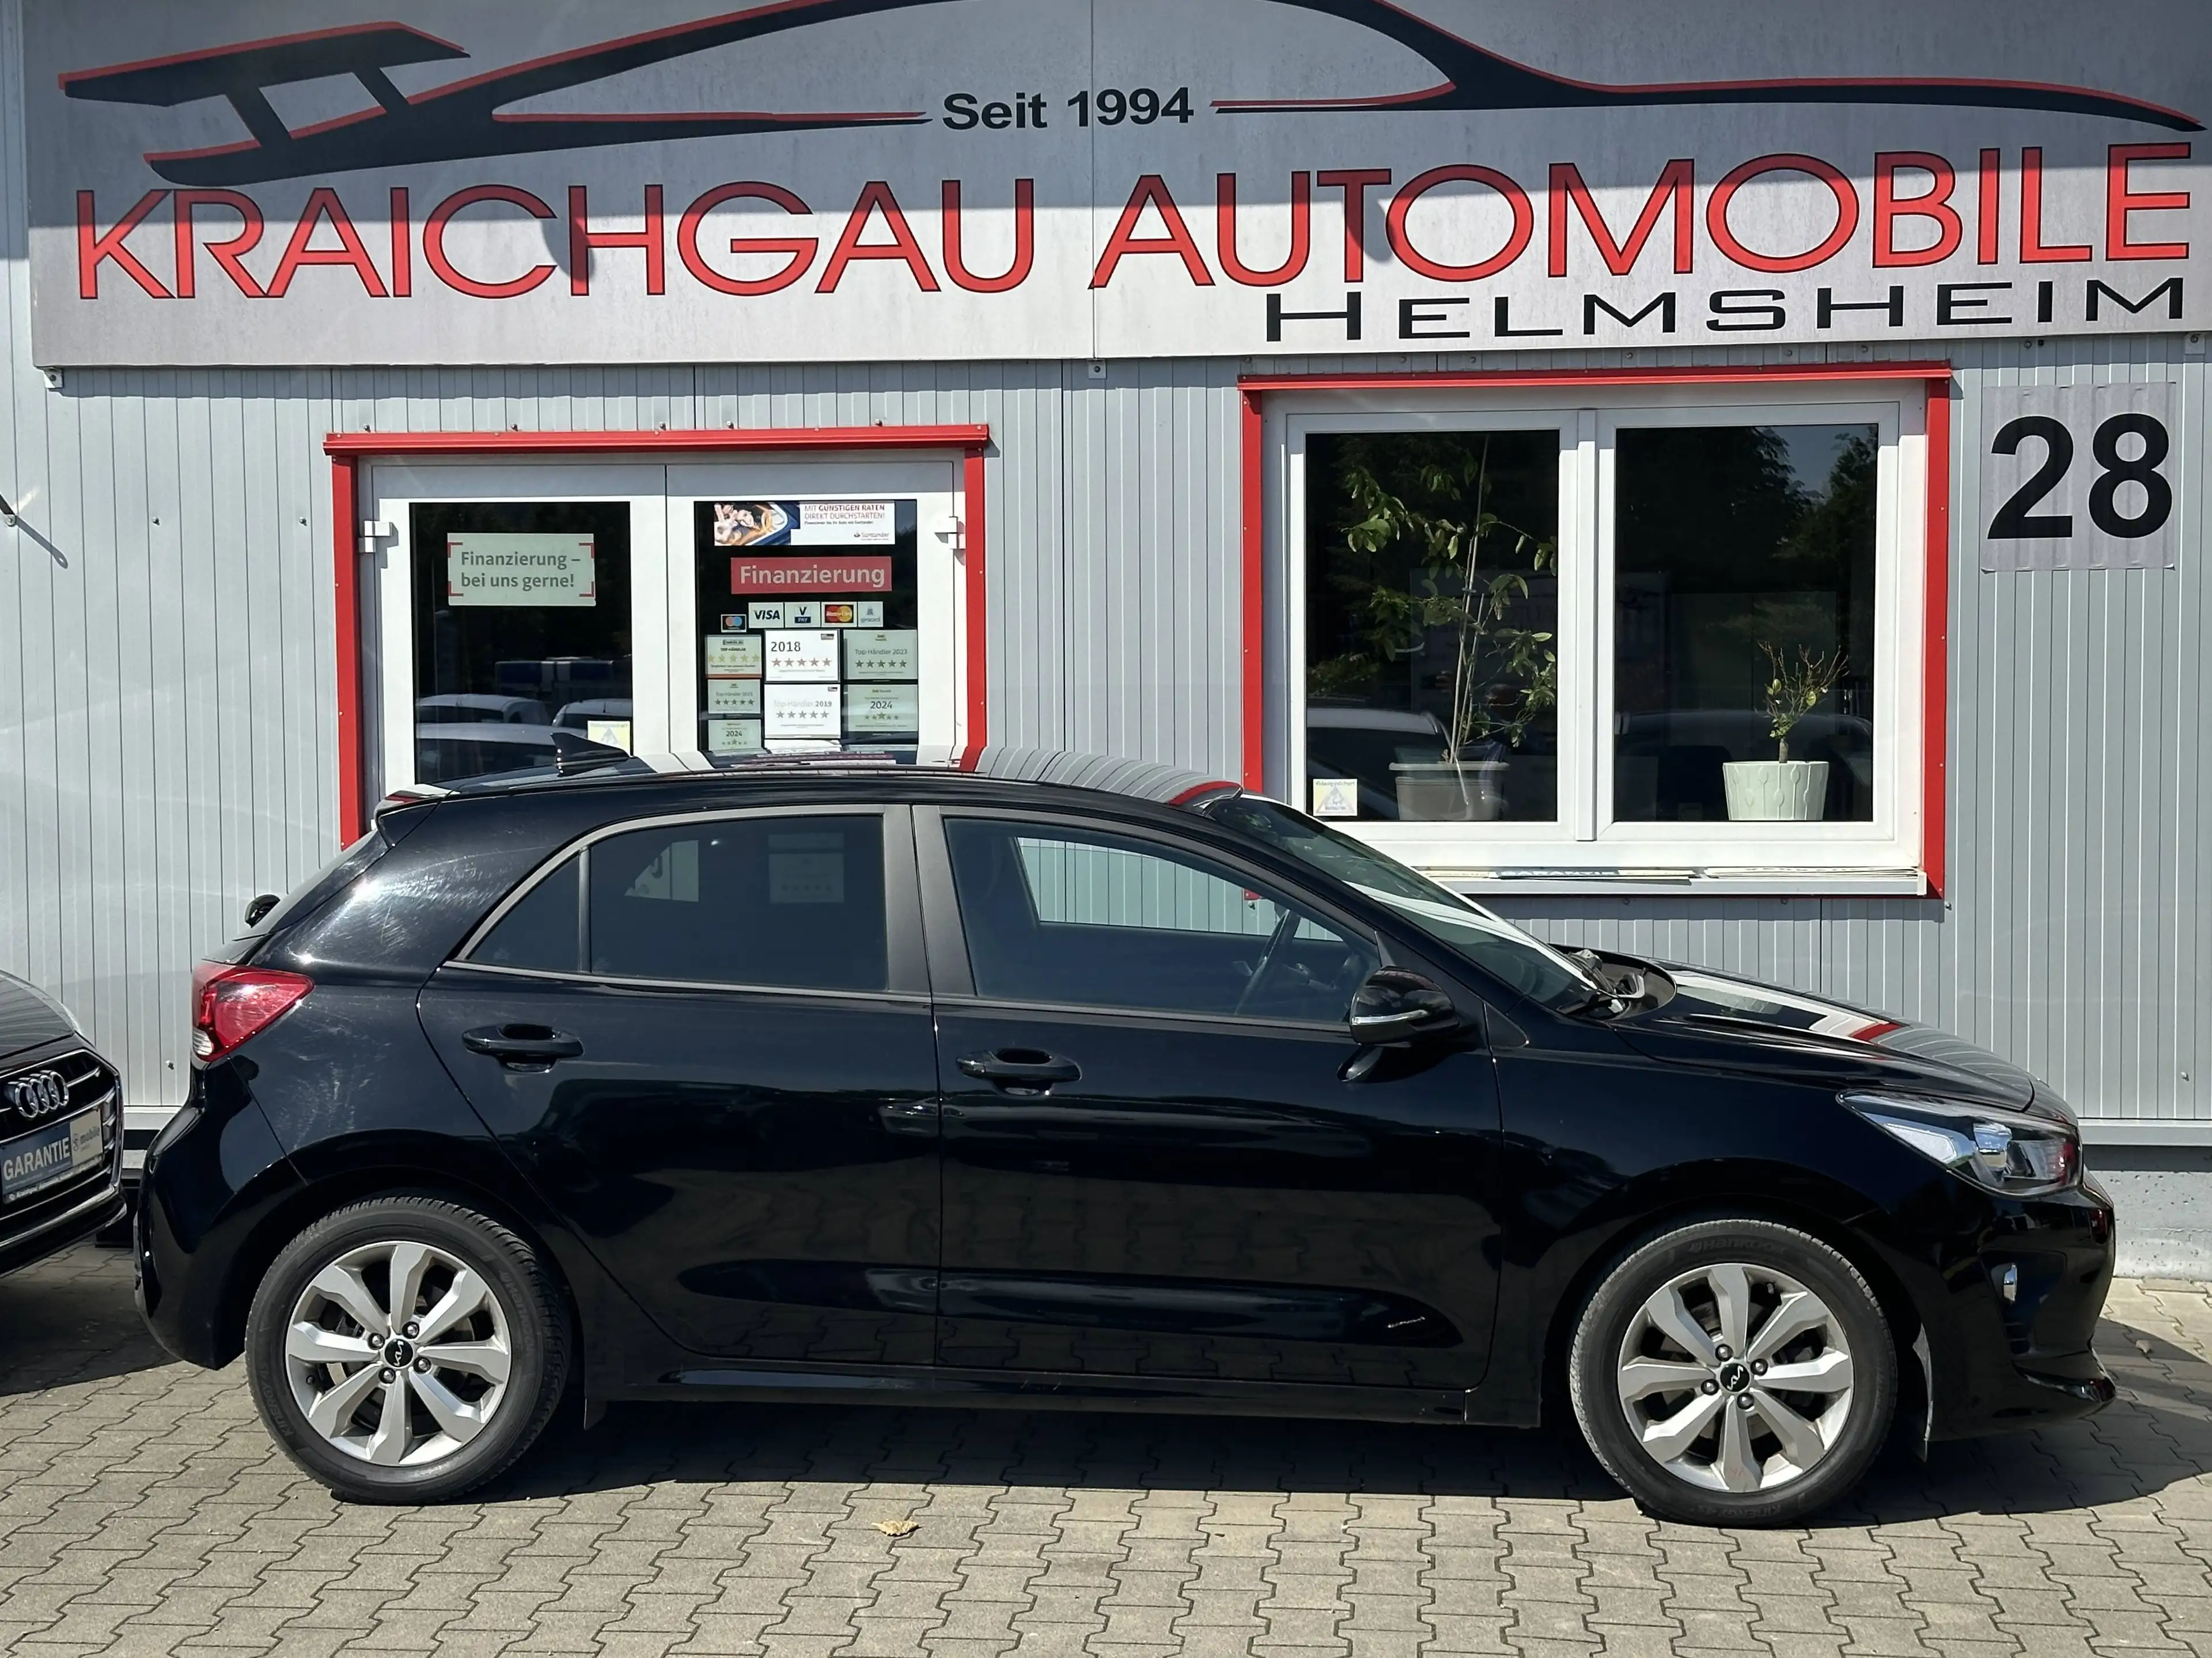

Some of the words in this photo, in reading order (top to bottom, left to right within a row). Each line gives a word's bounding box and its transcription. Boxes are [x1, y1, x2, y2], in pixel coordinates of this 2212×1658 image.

[942, 92, 1048, 130] Seit
[1067, 87, 1194, 127] 1994
[76, 179, 1036, 300] KRAICHGAU
[1090, 142, 2191, 289] AUTOMOBILE
[1266, 277, 2184, 342] HELMSHEIM
[1987, 413, 2172, 540] 28
[819, 503, 859, 511] GÜNSTIGEN
[461, 552, 567, 570] Finanzierung
[461, 572, 485, 587] bei
[490, 576, 518, 587] uns
[522, 574, 574, 591] gerne!
[740, 564, 885, 588] Finanzierung
[753, 609, 781, 620] VISA
[799, 606, 807, 616] V
[771, 641, 801, 652] 2018
[870, 701, 892, 709] 2024
[3, 1137, 70, 1181] GARANTIE
